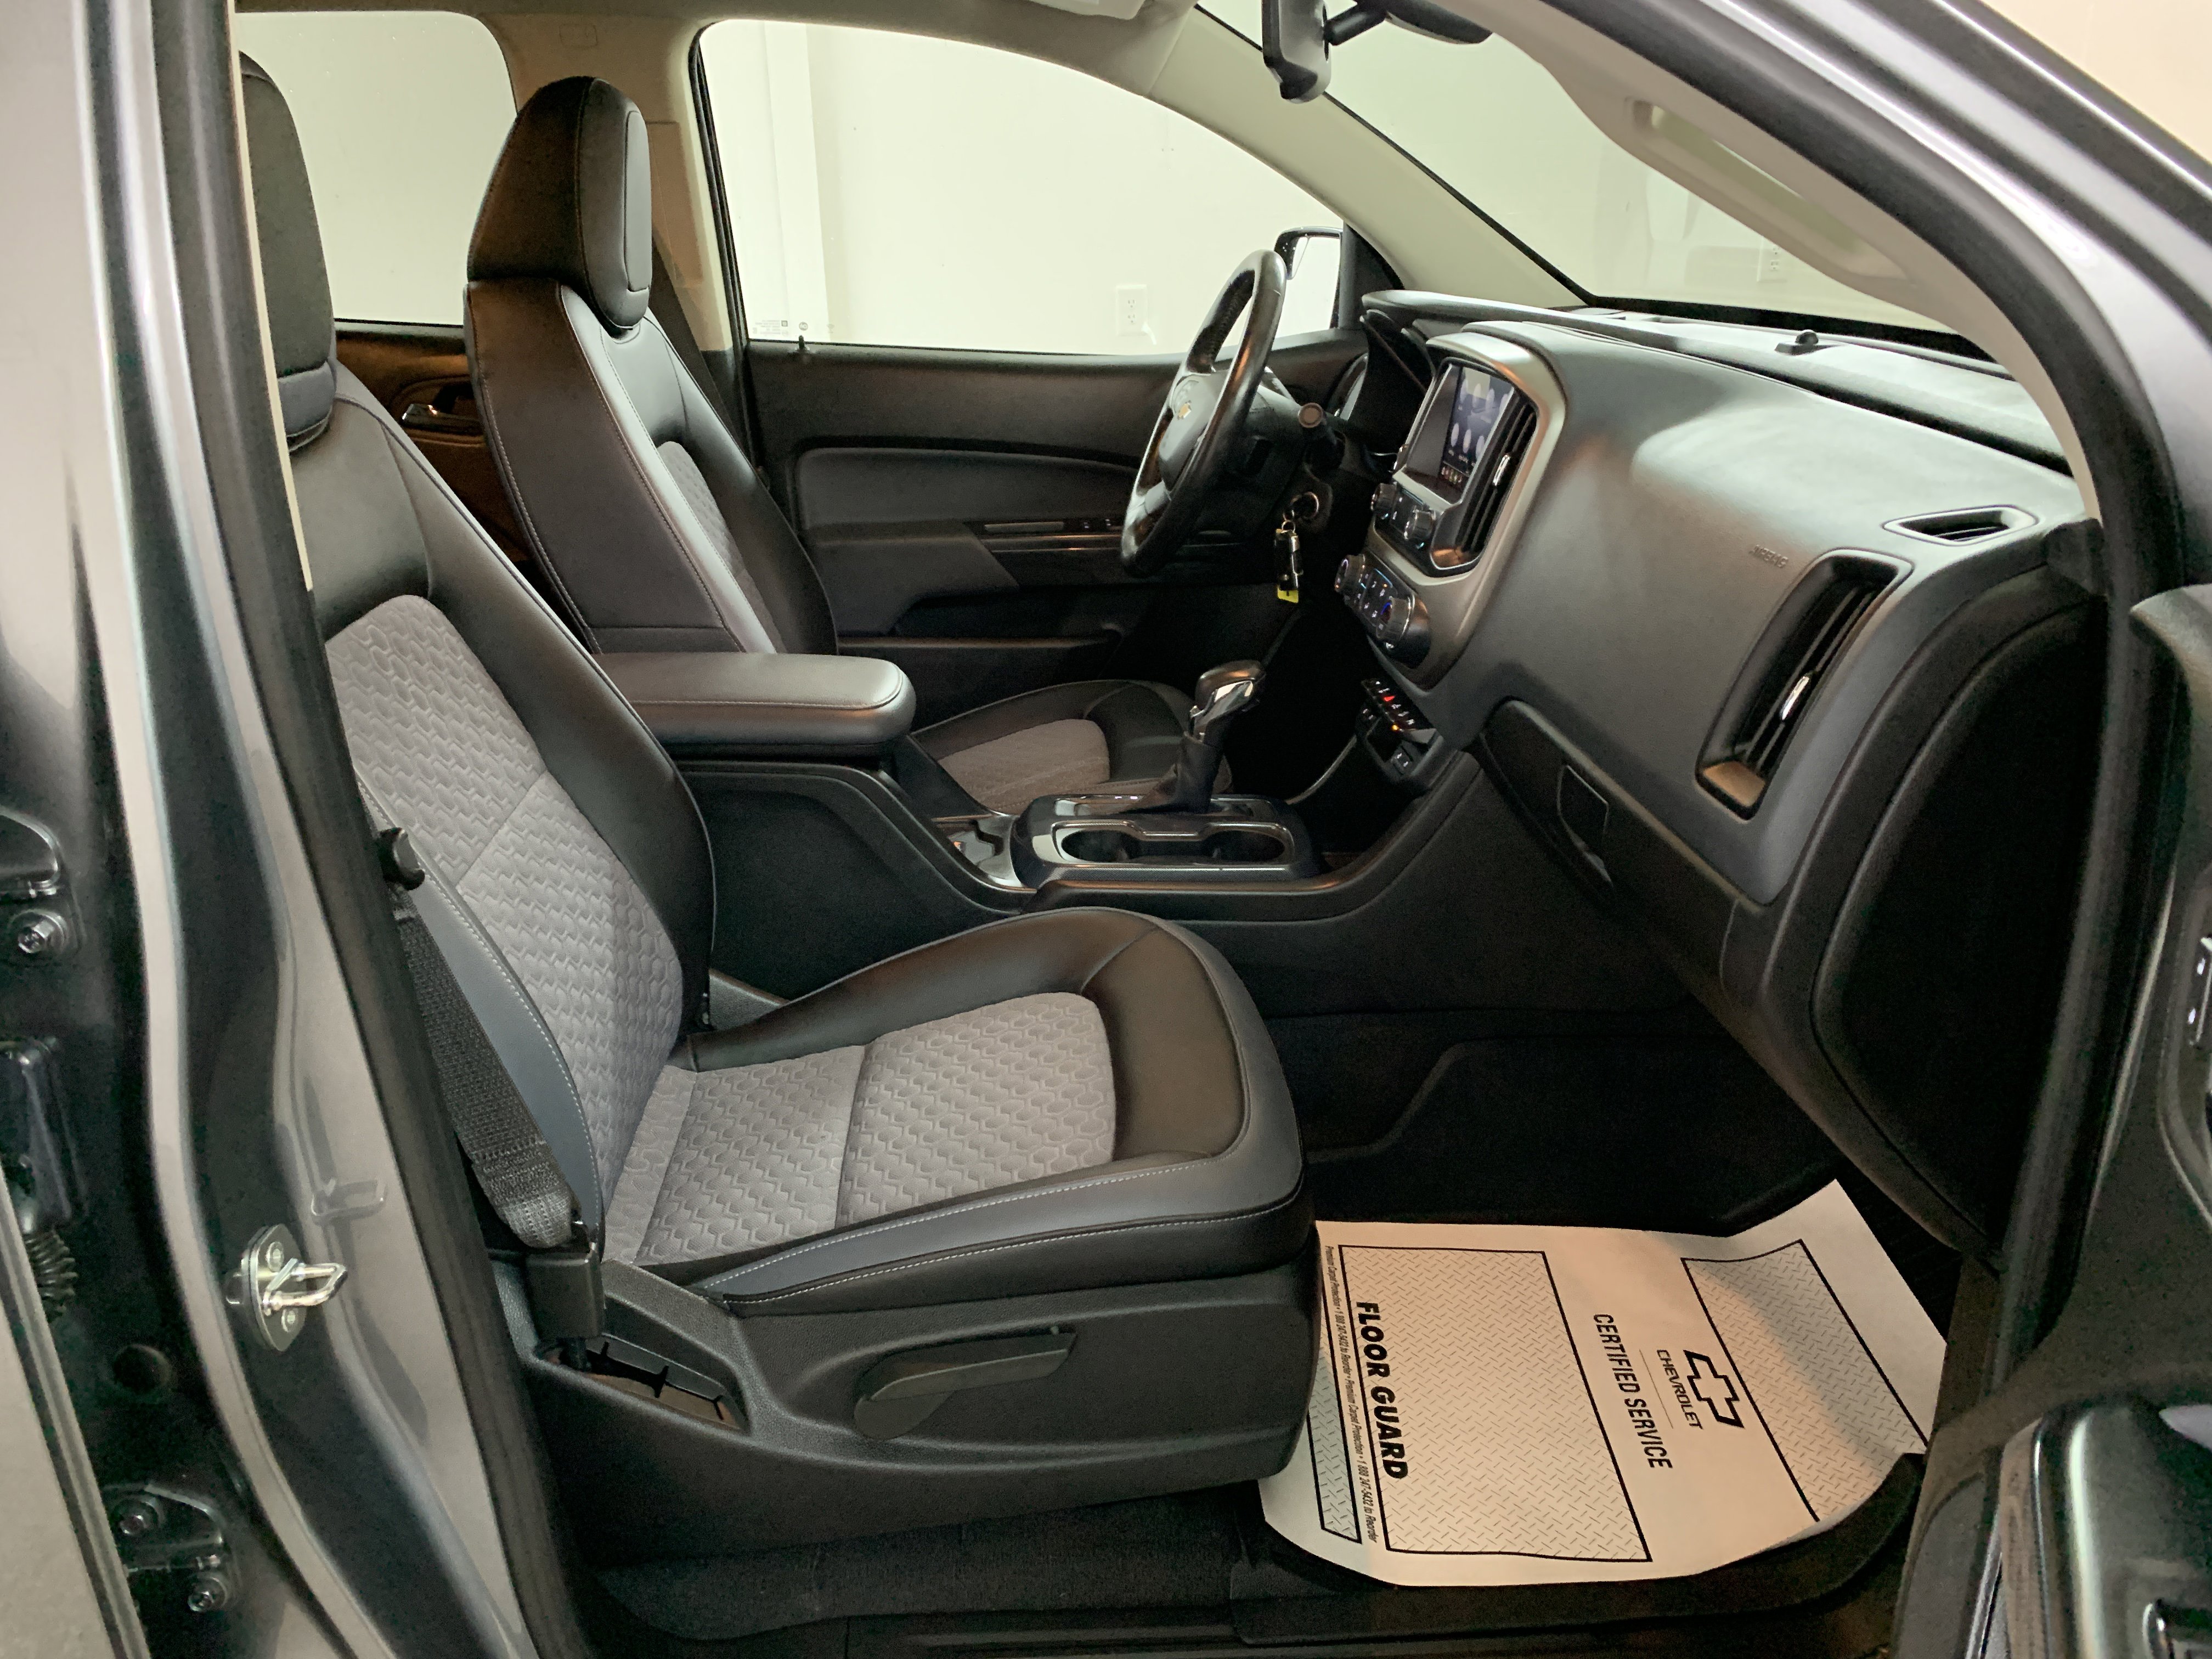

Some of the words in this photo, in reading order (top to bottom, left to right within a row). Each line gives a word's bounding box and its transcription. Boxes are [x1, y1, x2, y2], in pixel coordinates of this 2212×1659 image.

[1356, 1301, 1390, 1377] FLOOR
[1370, 1386, 1408, 1479] GUARD
[1593, 1314, 1640, 1392] CERTIFIED
[1624, 1398, 1673, 1469] SERVICE
[1656, 1350, 1703, 1430] CHEVROLET
